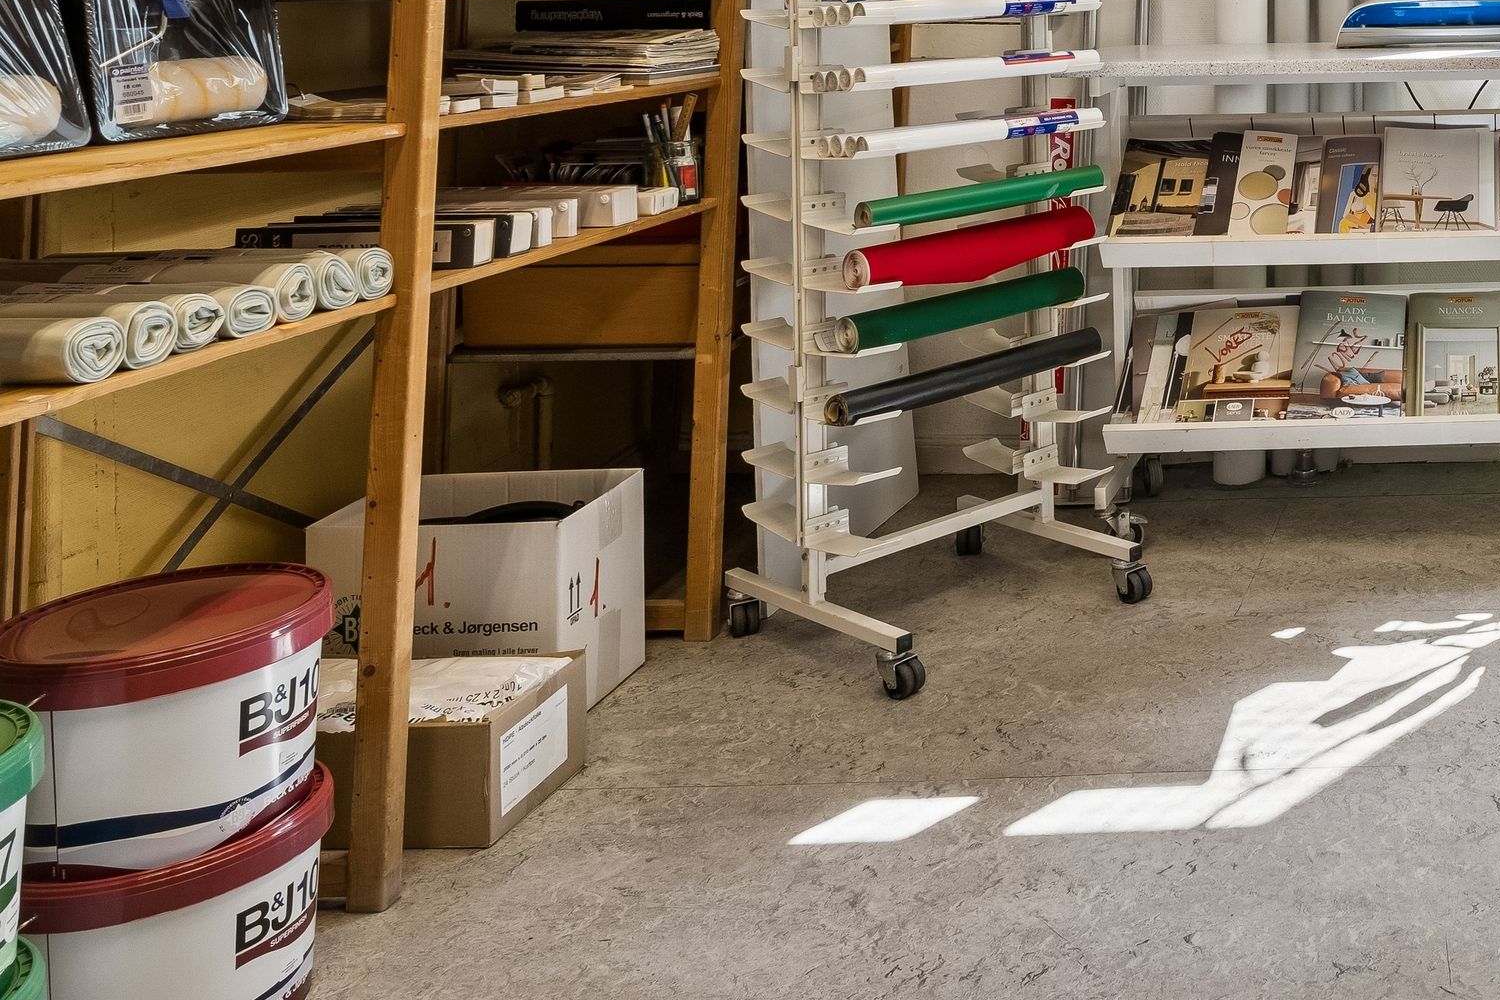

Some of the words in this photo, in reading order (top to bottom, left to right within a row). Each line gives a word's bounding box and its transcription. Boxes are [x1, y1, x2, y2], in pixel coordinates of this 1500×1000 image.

[530, 8, 604, 22] Vægbeklædning
[1222, 154, 1240, 163] INN
[1326, 312, 1377, 324] BALANCE
[1338, 306, 1367, 315] LADY
[1438, 306, 1484, 315] NUANCES
[414, 621, 439, 635] eck
[443, 622, 454, 635] &
[458, 619, 538, 636] Jørgensen
[239, 657, 320, 742] B&J10
[273, 710, 310, 739] SUPERFINISH
[236, 856, 318, 955] B&J10
[270, 912, 308, 948] SUPERFINISH
